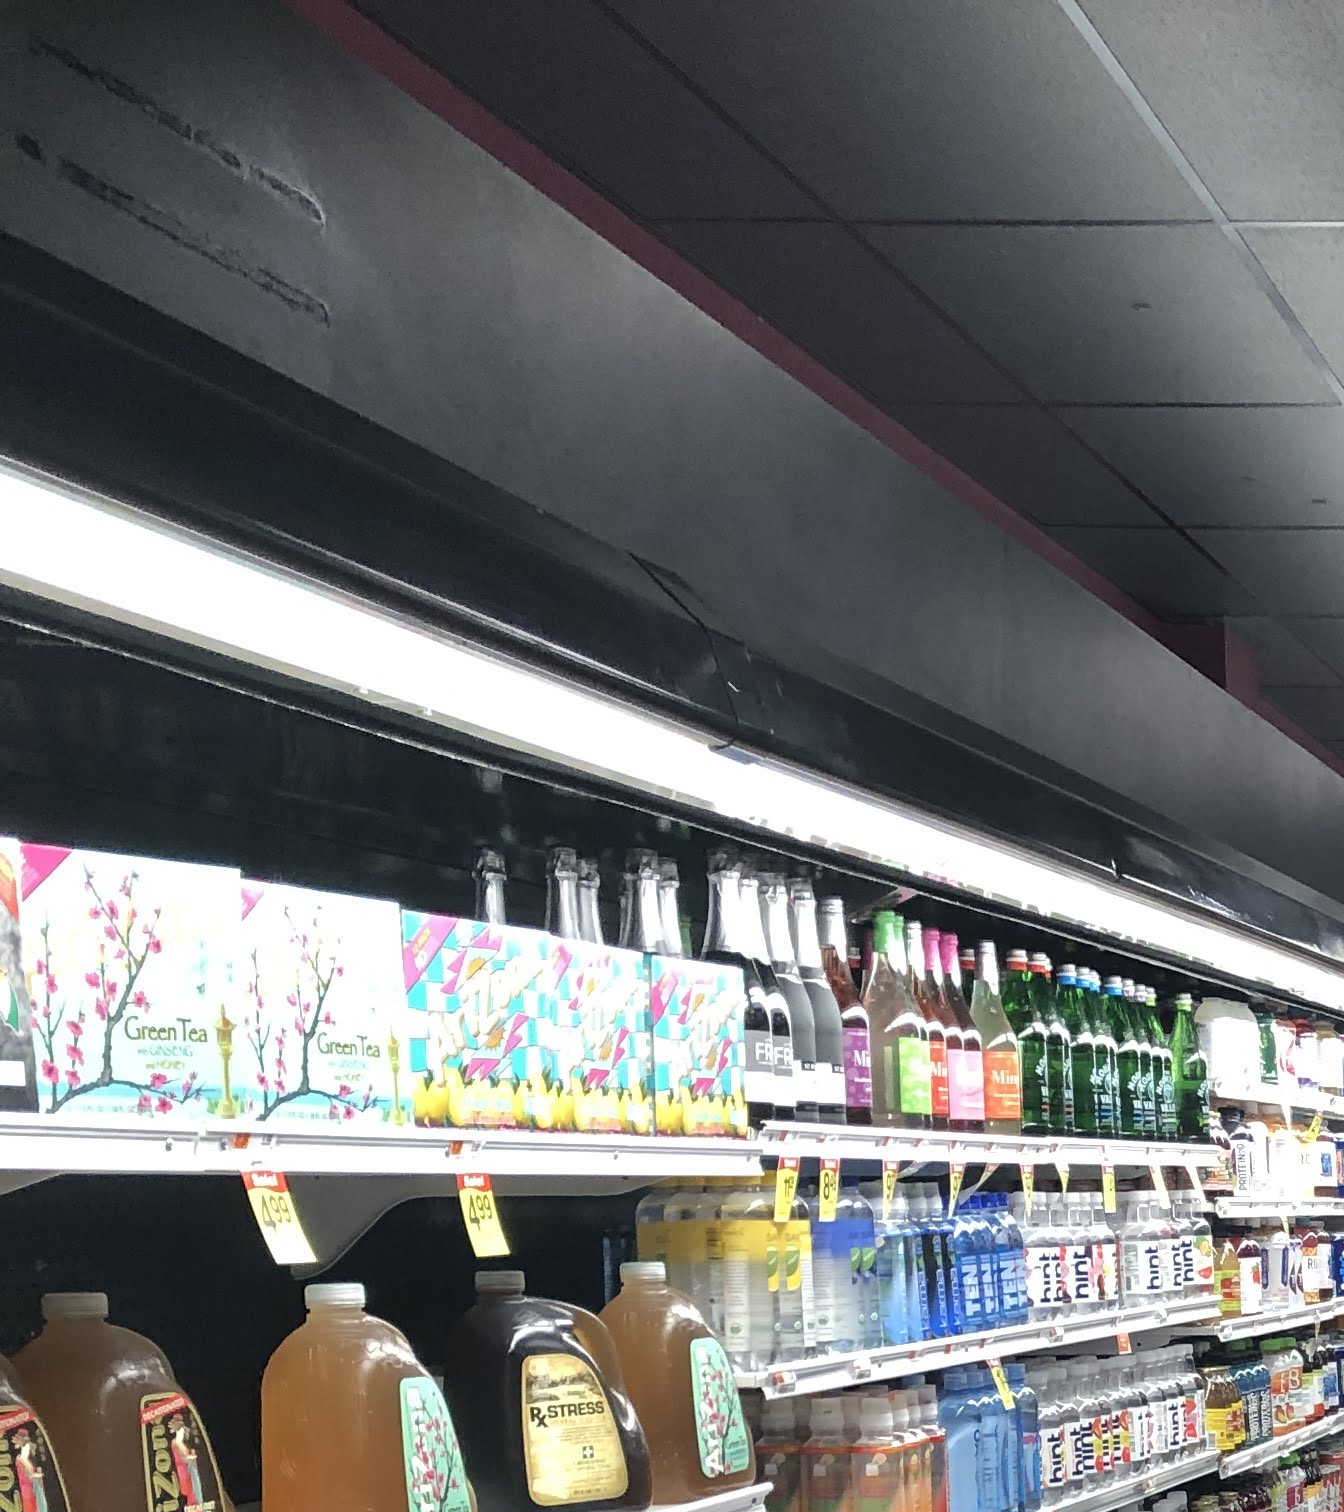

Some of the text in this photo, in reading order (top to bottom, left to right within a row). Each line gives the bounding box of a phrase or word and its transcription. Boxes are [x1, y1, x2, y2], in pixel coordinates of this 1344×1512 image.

[124, 1016, 208, 1043] Green Tea
[317, 1032, 381, 1058] Green Tea
[546, 1400, 606, 1419] STRESS
[1046, 1432, 1064, 1484] hint
